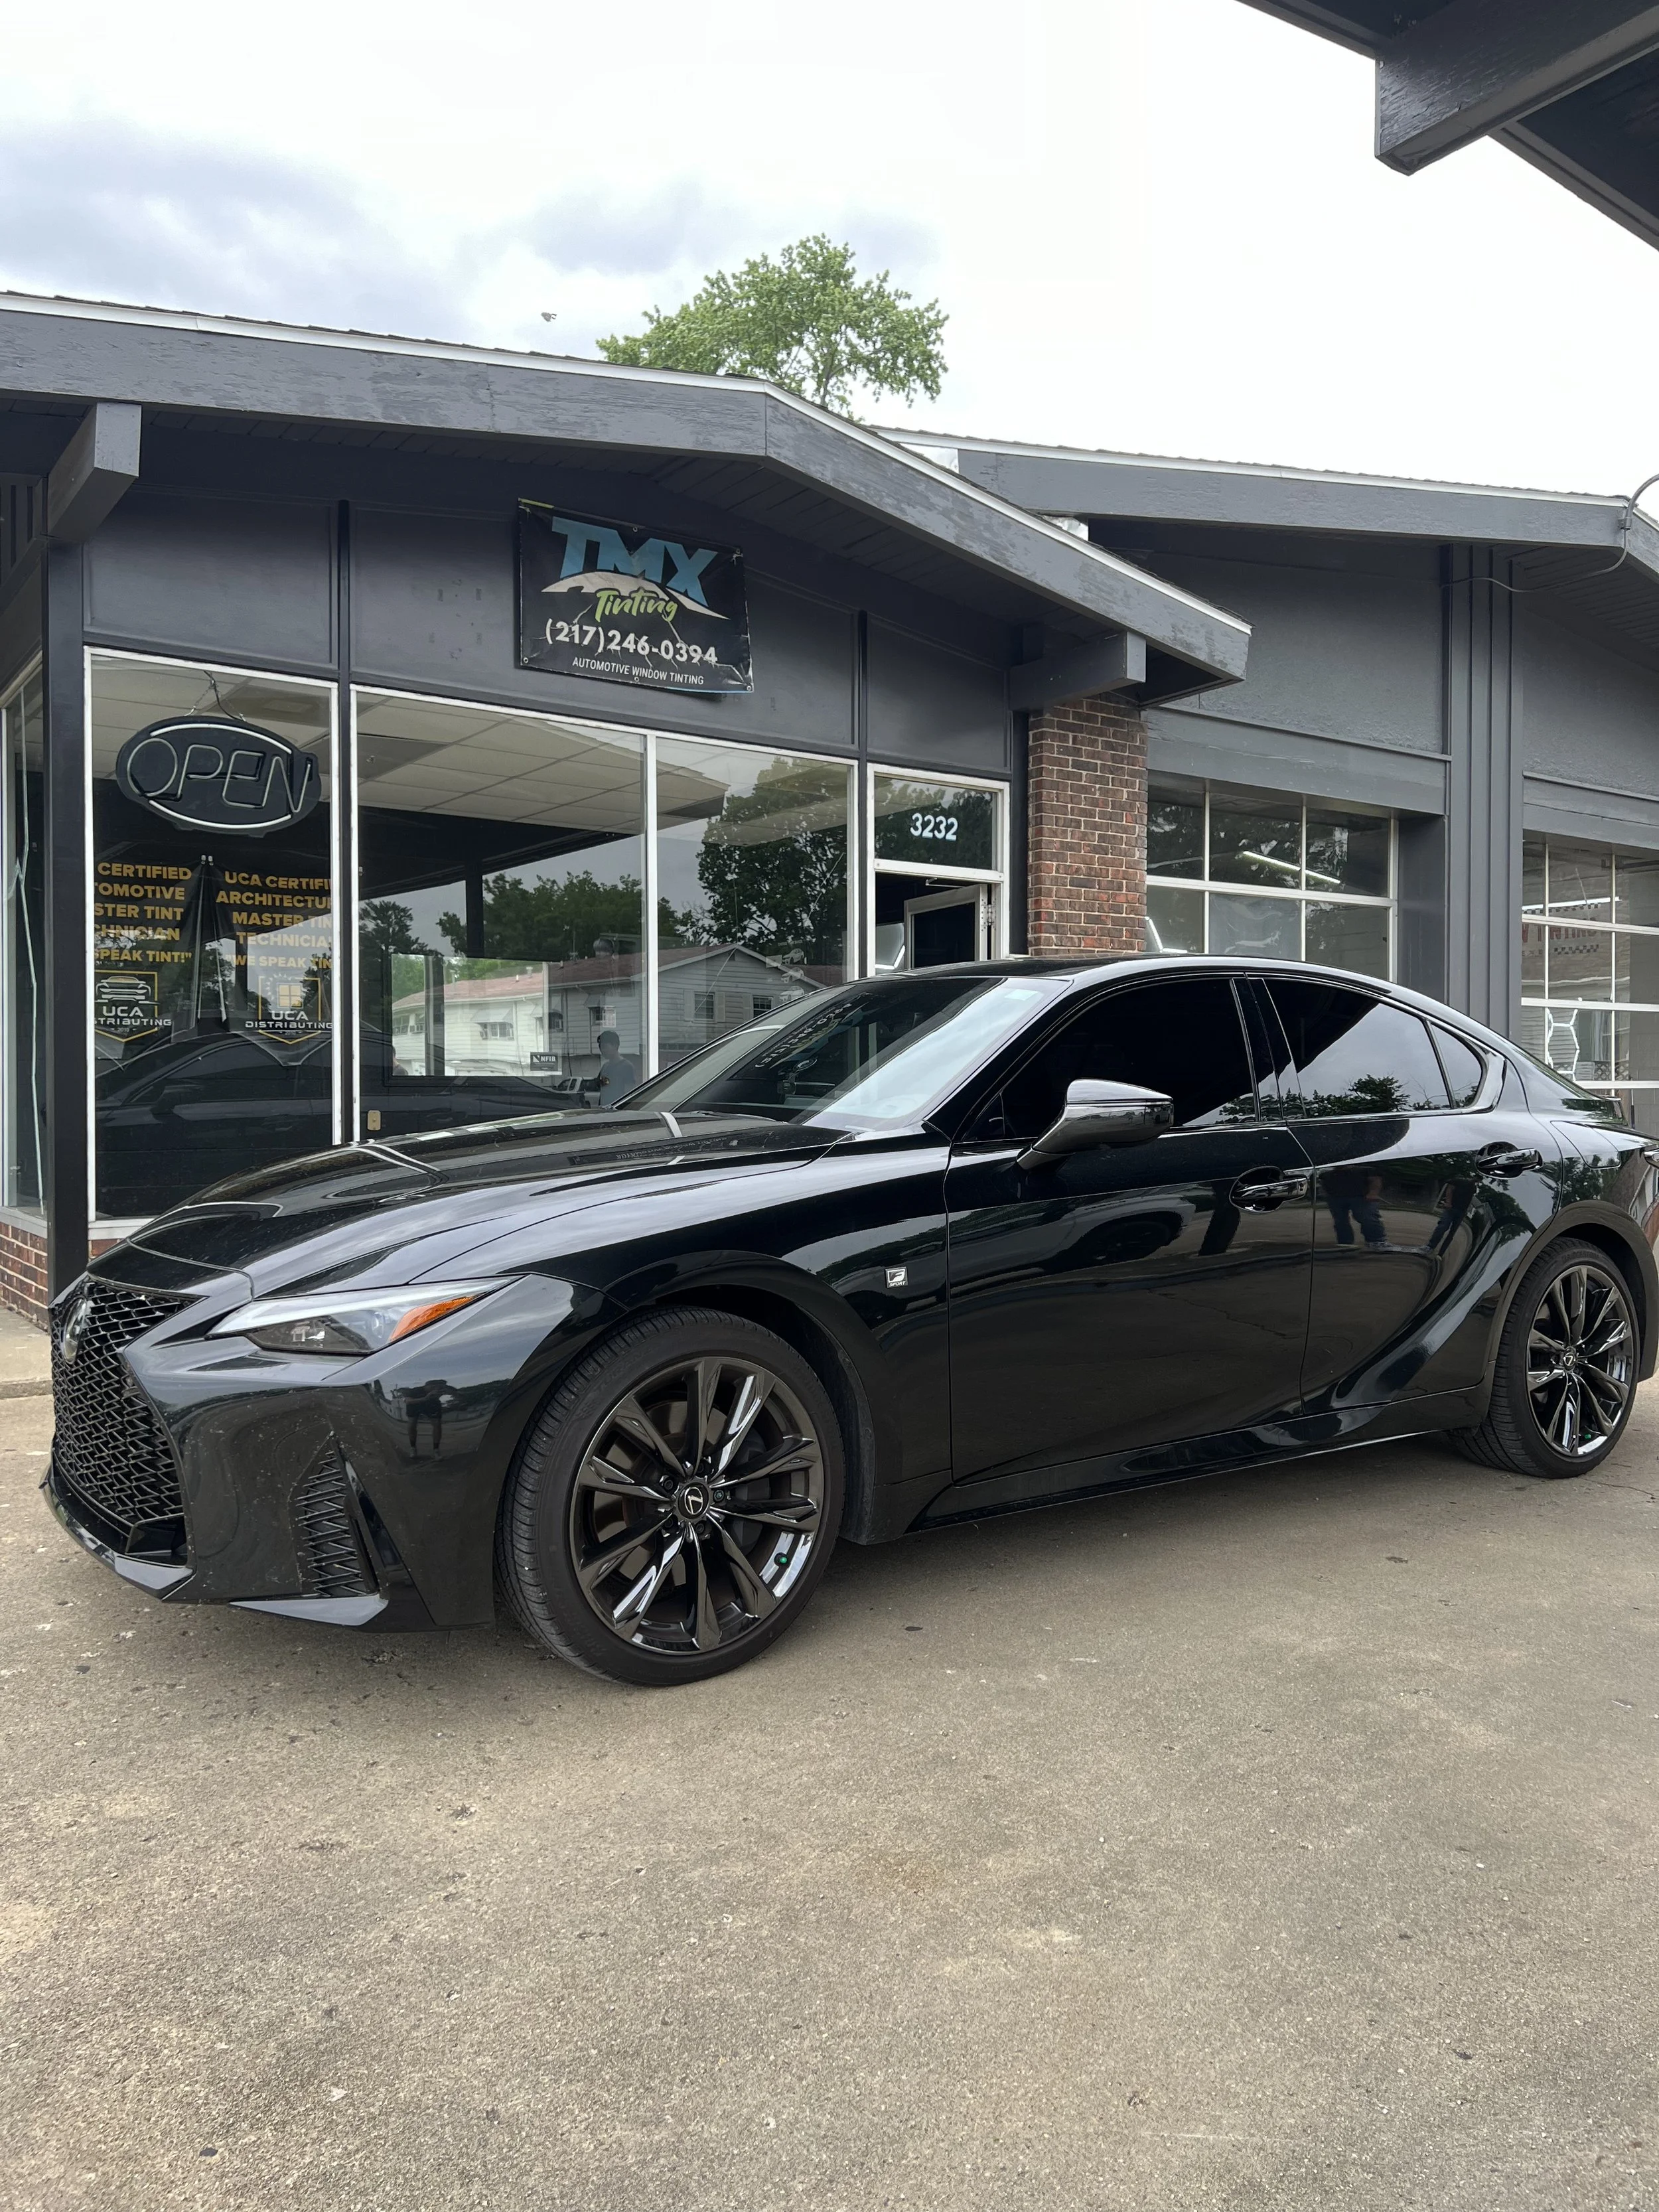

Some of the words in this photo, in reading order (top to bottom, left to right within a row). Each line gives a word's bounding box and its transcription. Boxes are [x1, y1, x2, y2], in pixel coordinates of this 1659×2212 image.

[551, 516, 718, 607] TMX
[595, 590, 678, 623] Tinting
[545, 618, 718, 664] (217)246-0394
[572, 656, 630, 675] AUTOMOTIVE
[632, 666, 668, 681] WINDOW
[669, 672, 704, 685] TINTING
[127, 737, 311, 813] OPEN
[910, 813, 958, 841] 3232
[98, 862, 192, 880] CERTIFIED
[225, 871, 262, 887] UCA
[265, 875, 331, 891] CERTIFI
[94, 882, 186, 901] OMOTIVE
[143, 905, 184, 921] TINT
[233, 911, 304, 927] MASTER
[236, 931, 331, 948] TECHNICIA
[145, 950, 192, 963] TINT!"
[259, 956, 307, 968] SPEAK
[102, 1005, 144, 1017] UCA
[271, 1010, 309, 1021] UCA
